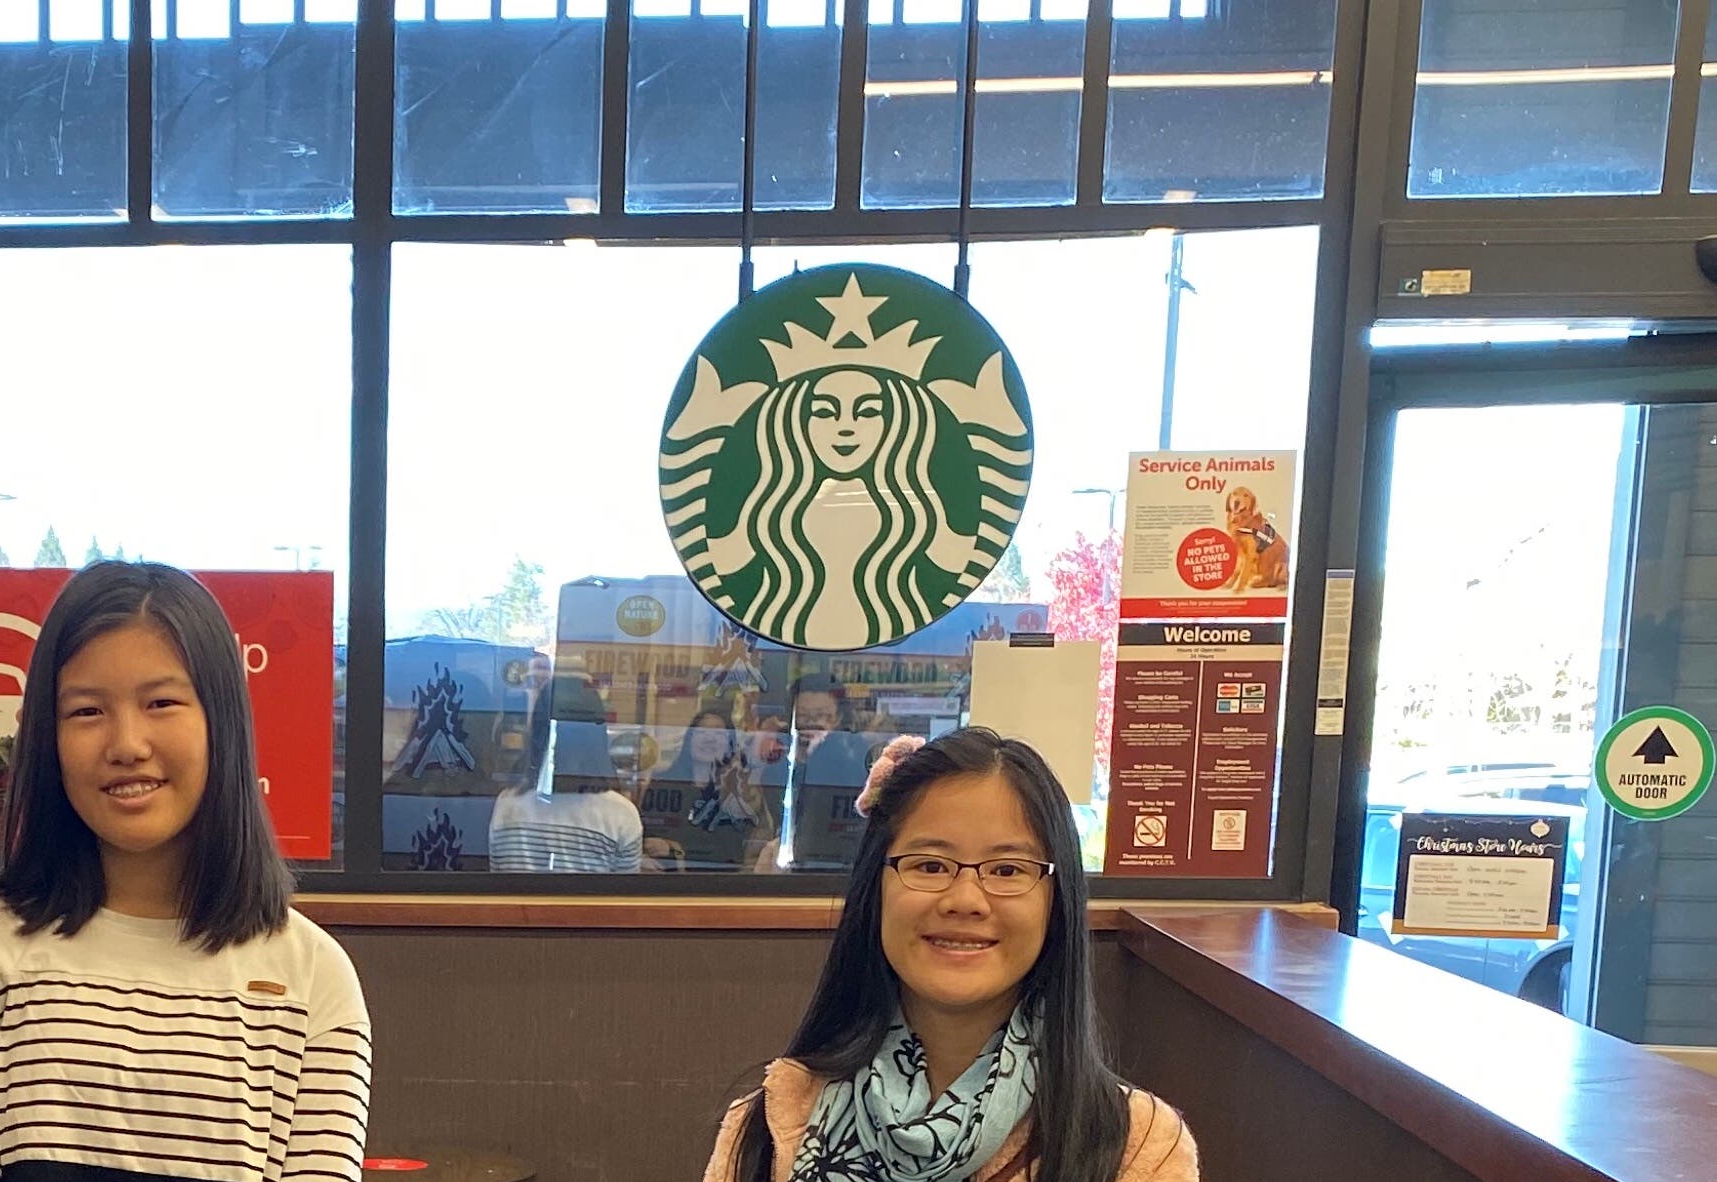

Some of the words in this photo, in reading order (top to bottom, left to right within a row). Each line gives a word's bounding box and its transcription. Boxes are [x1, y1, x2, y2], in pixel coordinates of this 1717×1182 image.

[1139, 458, 1201, 473] Service
[1205, 457, 1275, 472] Animals
[1186, 476, 1227, 493] Only
[1187, 547, 1202, 556] NO
[1204, 544, 1225, 554] PETS
[1184, 553, 1230, 566] ALLOWED
[1193, 565, 1203, 573] IN
[1204, 563, 1222, 571] THE
[1193, 571, 1223, 582] STORE
[1164, 626, 1251, 643] Welcome
[1618, 774, 1686, 786] AUTOMATIC
[1636, 787, 1667, 799] DOOR
[1416, 836, 1474, 853] Christmas
[1475, 837, 1505, 853] Store
[1508, 838, 1546, 856] Hours
